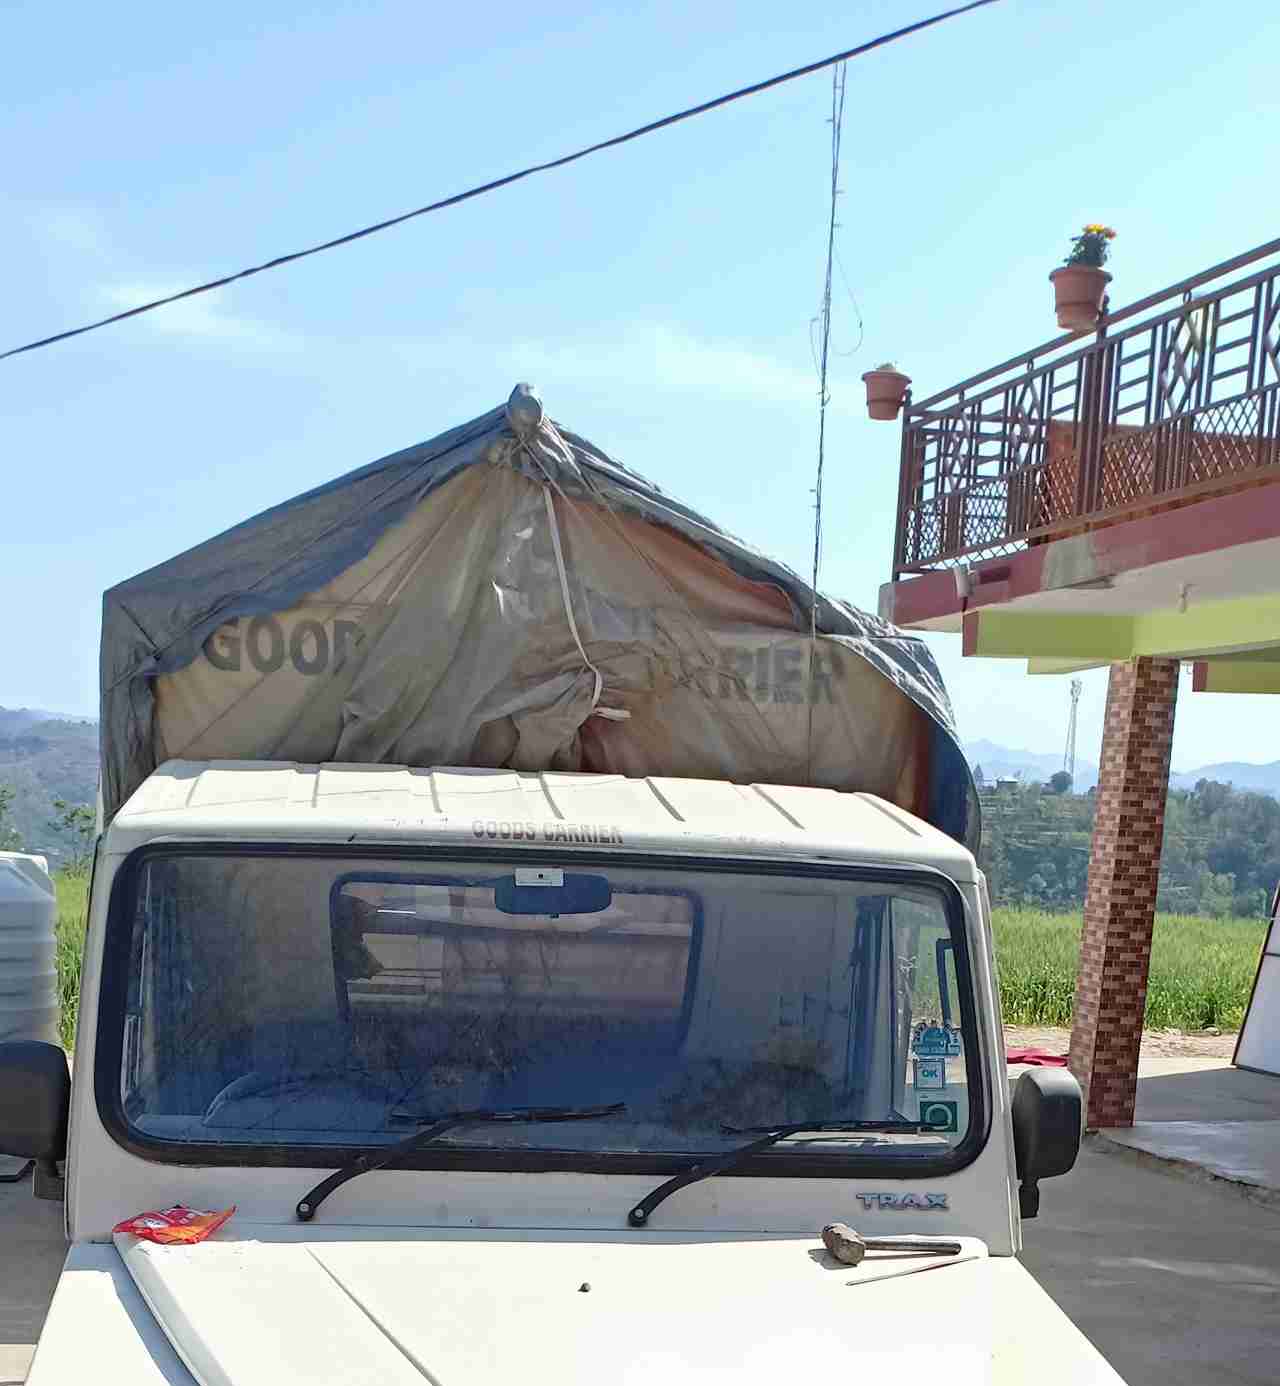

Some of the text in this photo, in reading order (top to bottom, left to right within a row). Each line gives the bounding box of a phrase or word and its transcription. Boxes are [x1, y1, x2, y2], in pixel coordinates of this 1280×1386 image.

[472, 820, 624, 845] GOODS CARRIER
[856, 1191, 949, 1211] TRAX
